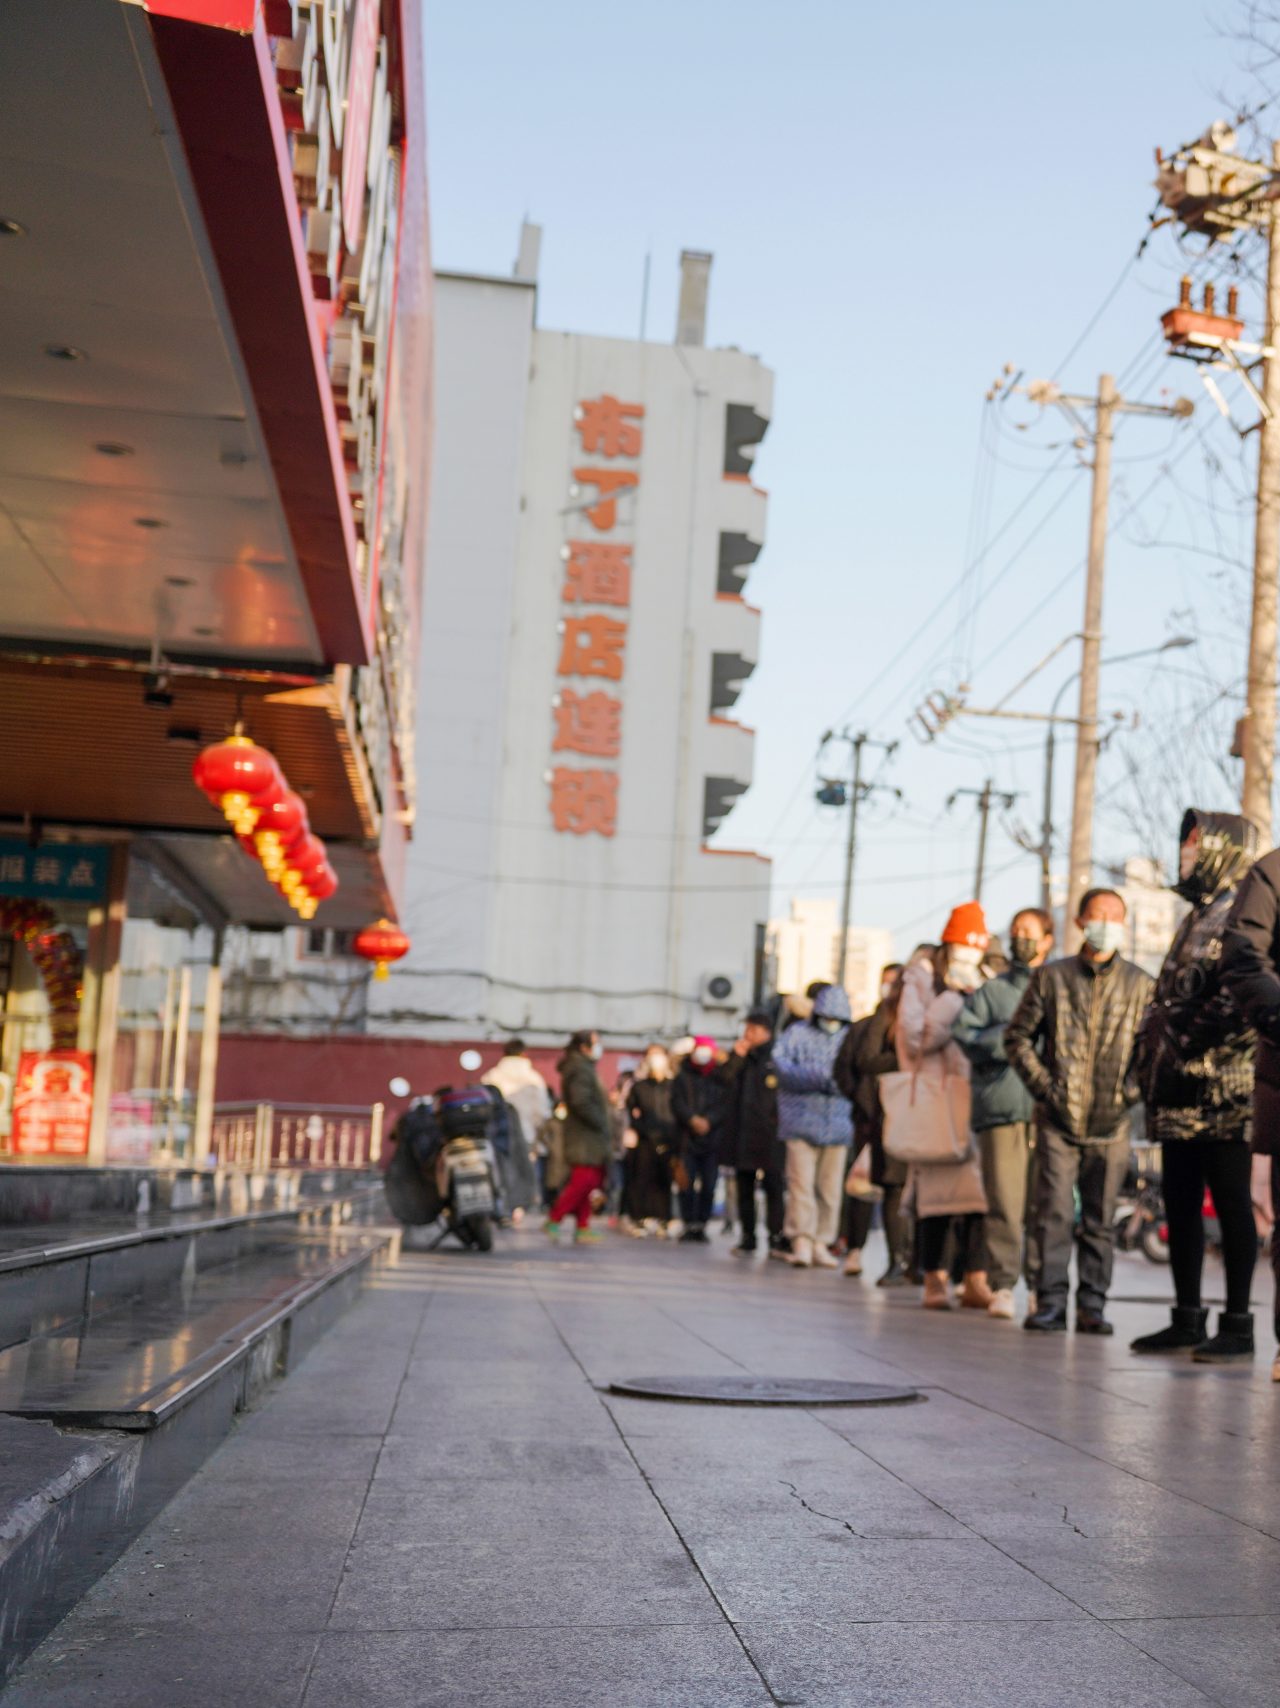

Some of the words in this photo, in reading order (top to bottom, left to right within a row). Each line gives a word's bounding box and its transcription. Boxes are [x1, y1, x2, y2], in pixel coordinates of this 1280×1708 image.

[549, 394, 645, 838] 布丁酒店连锁
